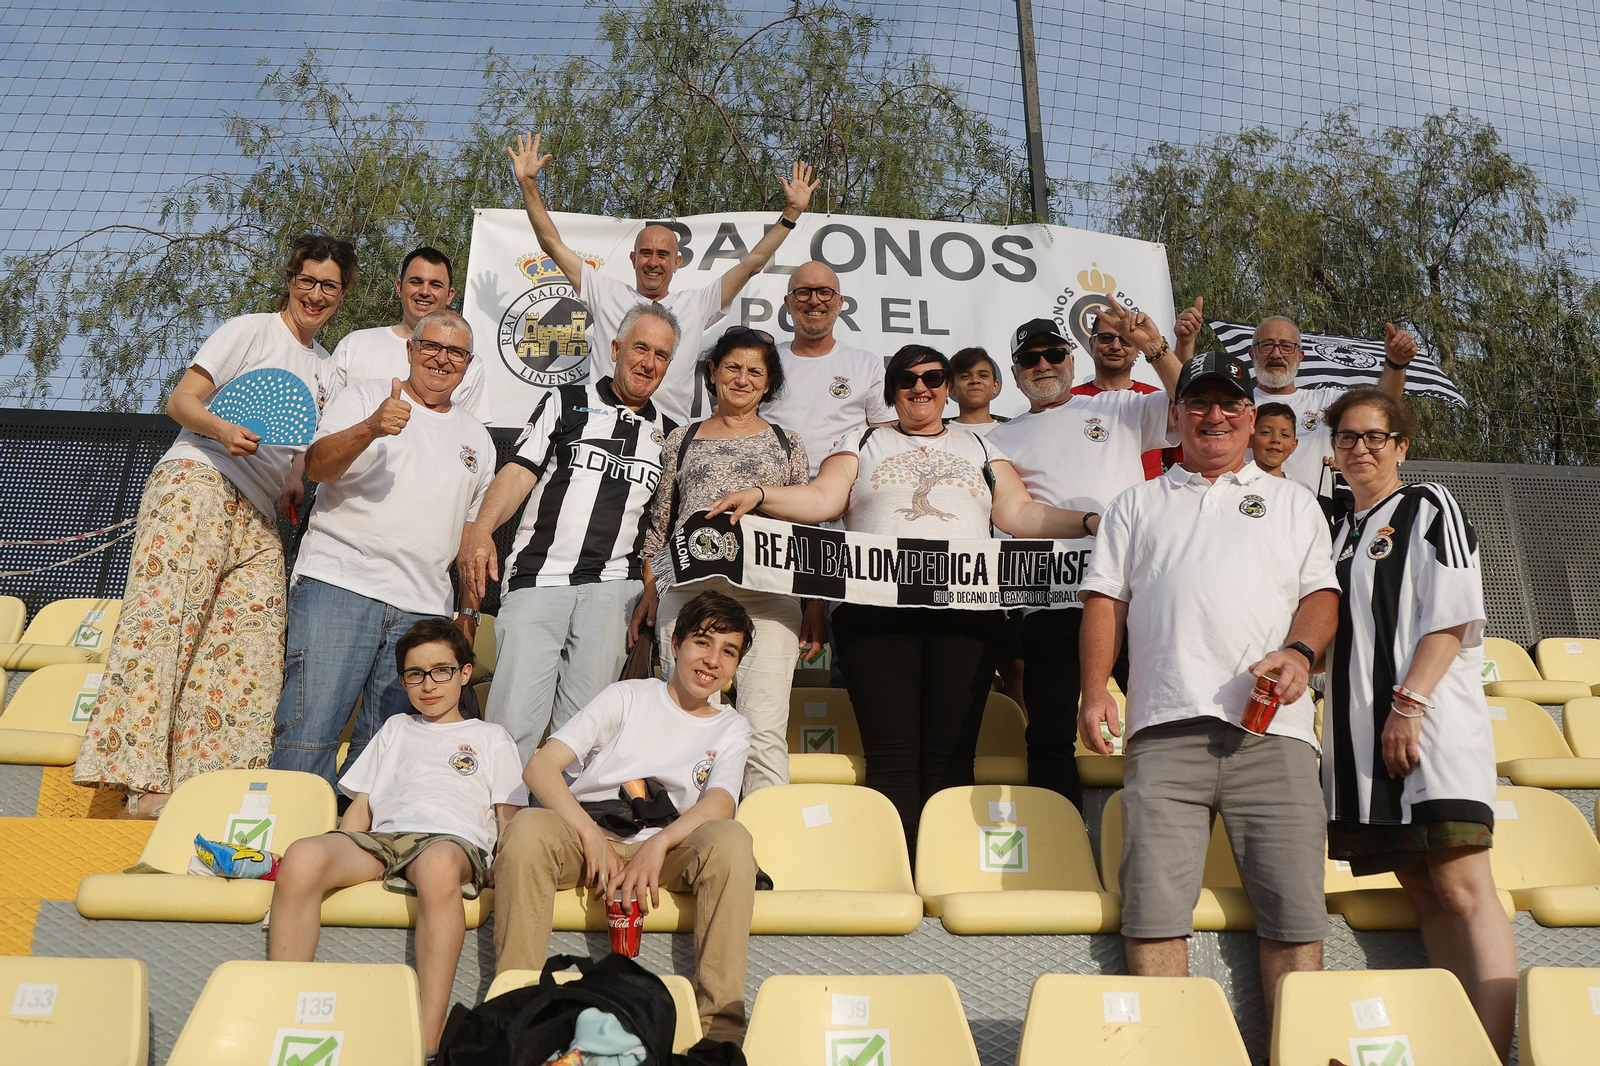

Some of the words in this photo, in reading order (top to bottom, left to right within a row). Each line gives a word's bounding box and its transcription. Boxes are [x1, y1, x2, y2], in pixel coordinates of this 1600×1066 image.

[880, 297, 950, 336] EL
[501, 313, 520, 346] REAL
[519, 365, 586, 385] LINENSE
[567, 443, 663, 494] LOTUS
[753, 530, 815, 574] REAL
[820, 539, 990, 586] BALOMPEDICA
[933, 590, 955, 604] CLUB
[956, 590, 988, 604] DECANO
[989, 591, 1003, 604] DEL
[1003, 590, 1035, 605] CAMPO
[1046, 590, 1080, 604] GIBRALT
[17, 988, 54, 1008] 133
[299, 996, 334, 1016] 135
[841, 1000, 868, 1019] 39
